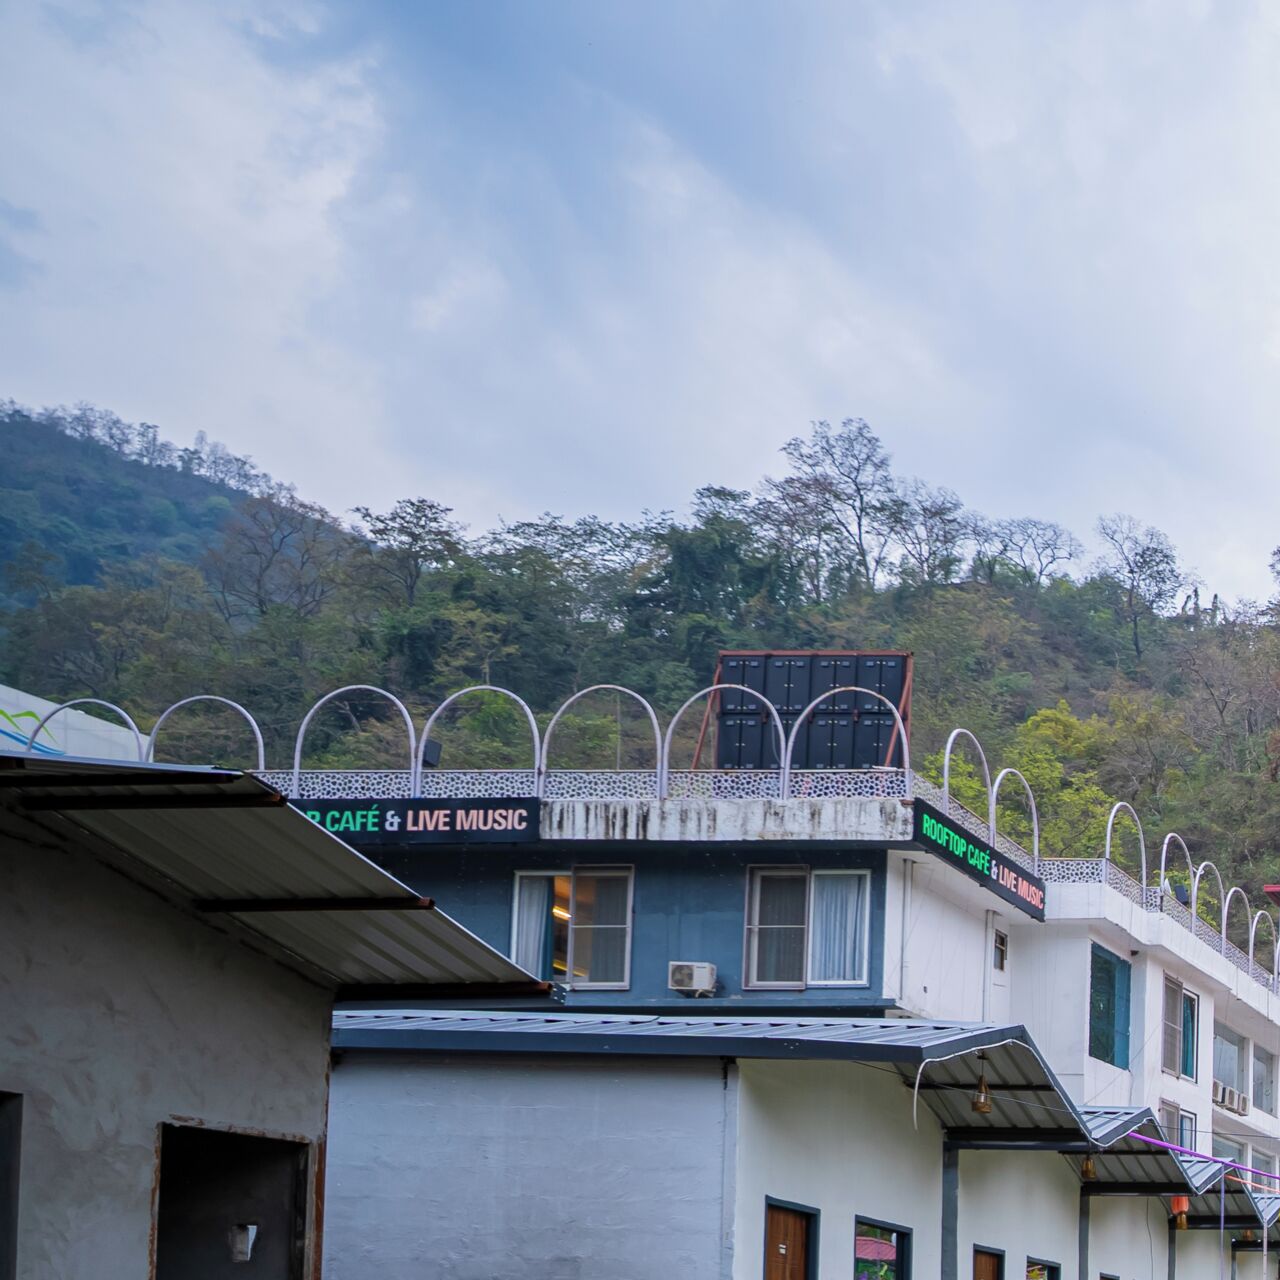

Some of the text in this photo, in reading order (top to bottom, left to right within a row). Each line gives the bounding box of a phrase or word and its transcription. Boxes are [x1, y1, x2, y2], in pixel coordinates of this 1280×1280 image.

[324, 804, 380, 832] CAFÉ
[384, 810, 401, 832] &
[406, 810, 450, 832] LIVE
[455, 809, 528, 831] MUSIC
[922, 813, 1044, 909] ROOFTOP CAFÉ & LIVE MUSIC
